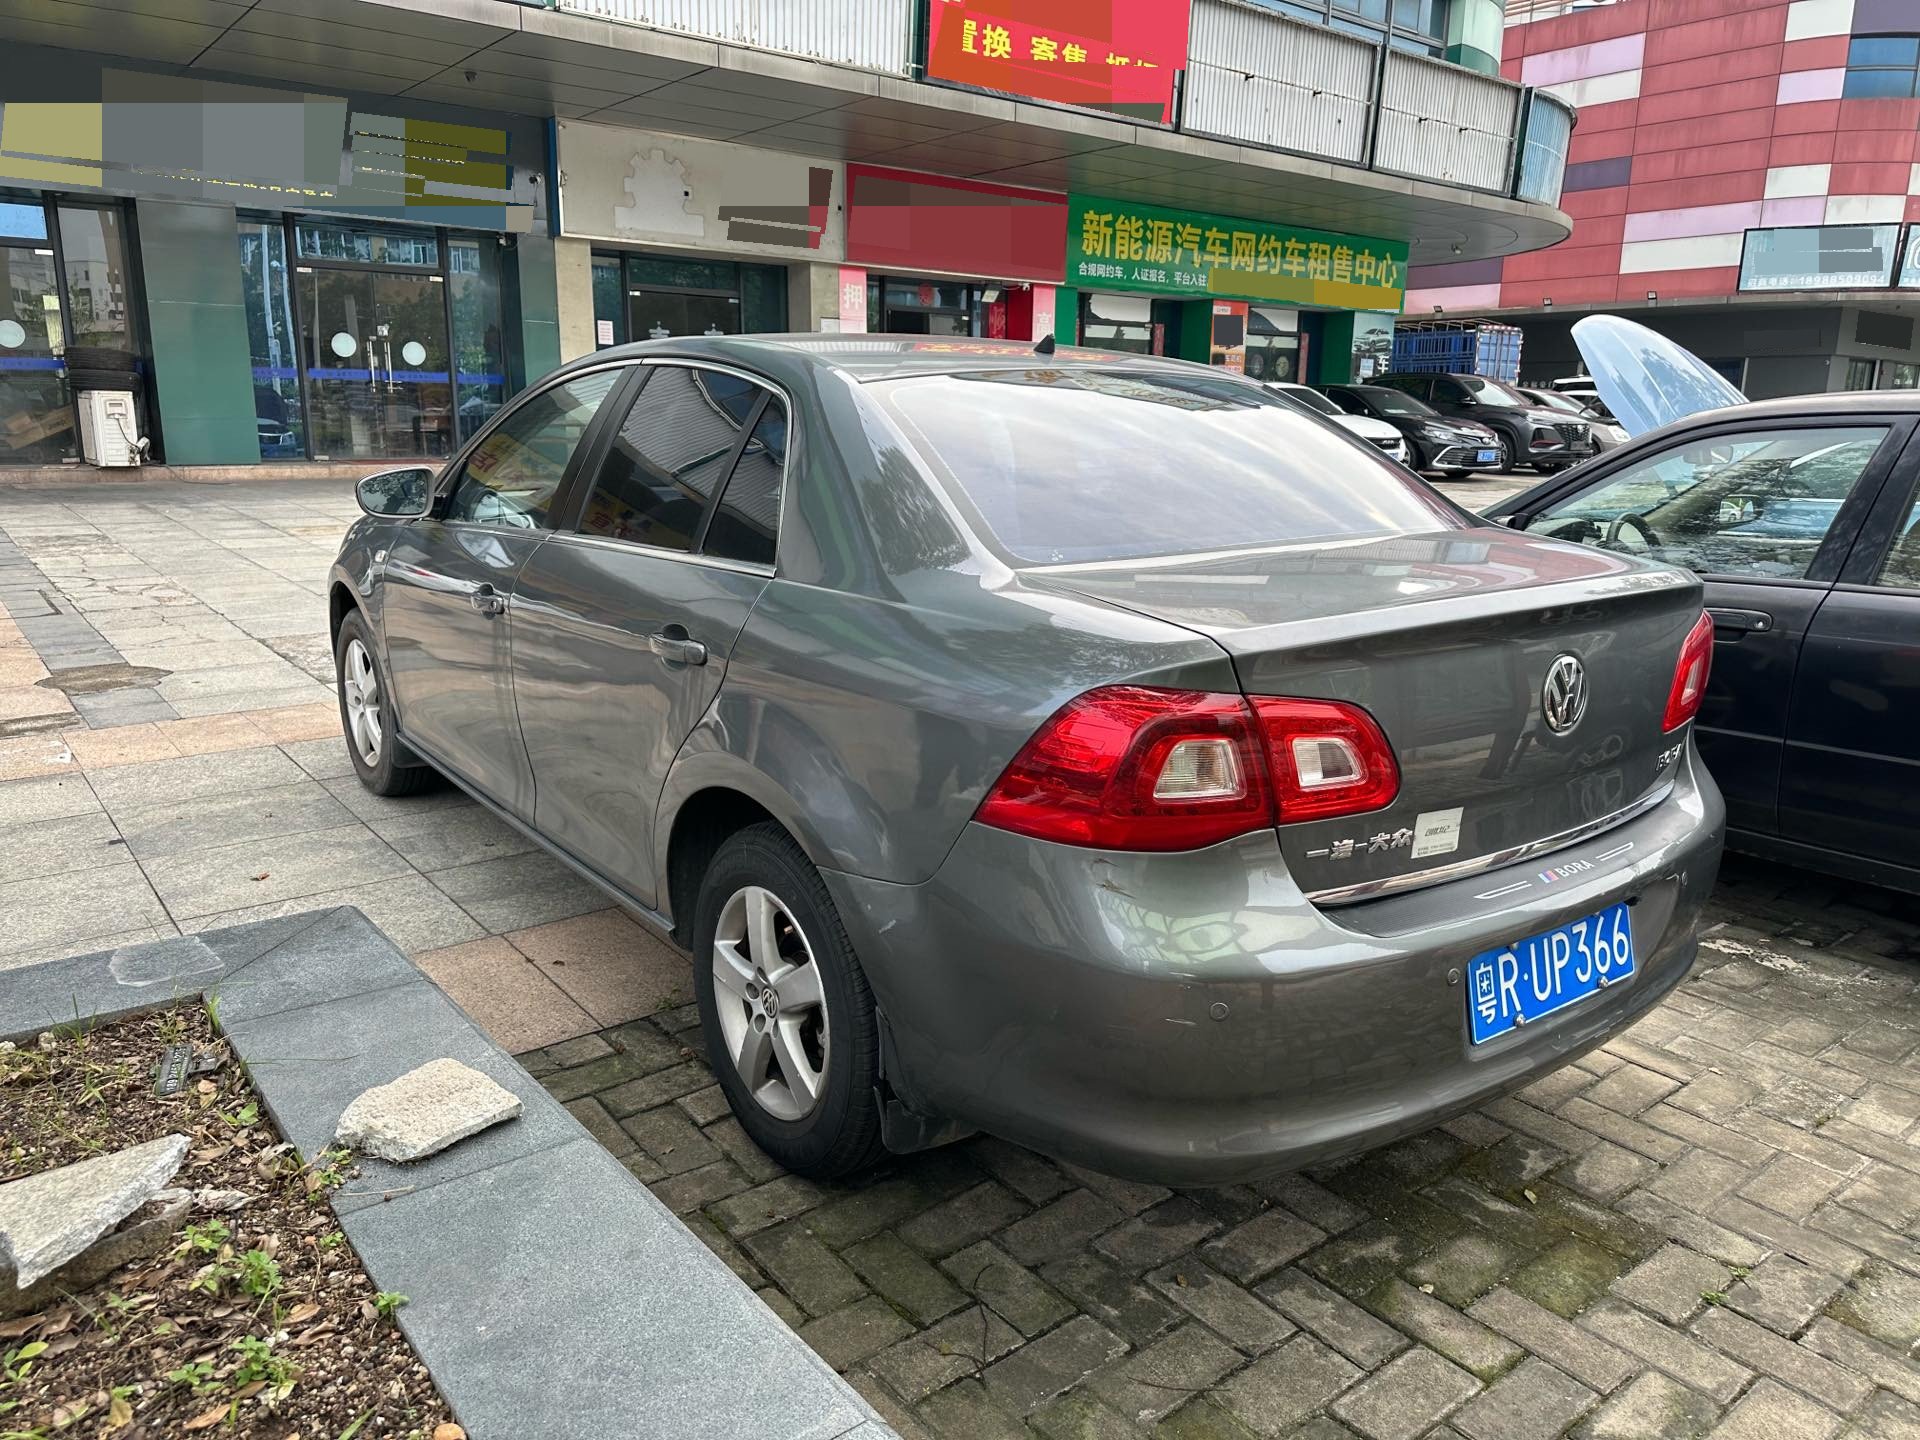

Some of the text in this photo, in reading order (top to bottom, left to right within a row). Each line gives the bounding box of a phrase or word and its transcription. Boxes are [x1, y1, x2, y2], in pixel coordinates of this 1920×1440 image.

[1081, 209, 1397, 289] 新能源汽车网约车租售中心
[843, 283, 863, 309] 押
[1555, 859, 1593, 878] BORA
